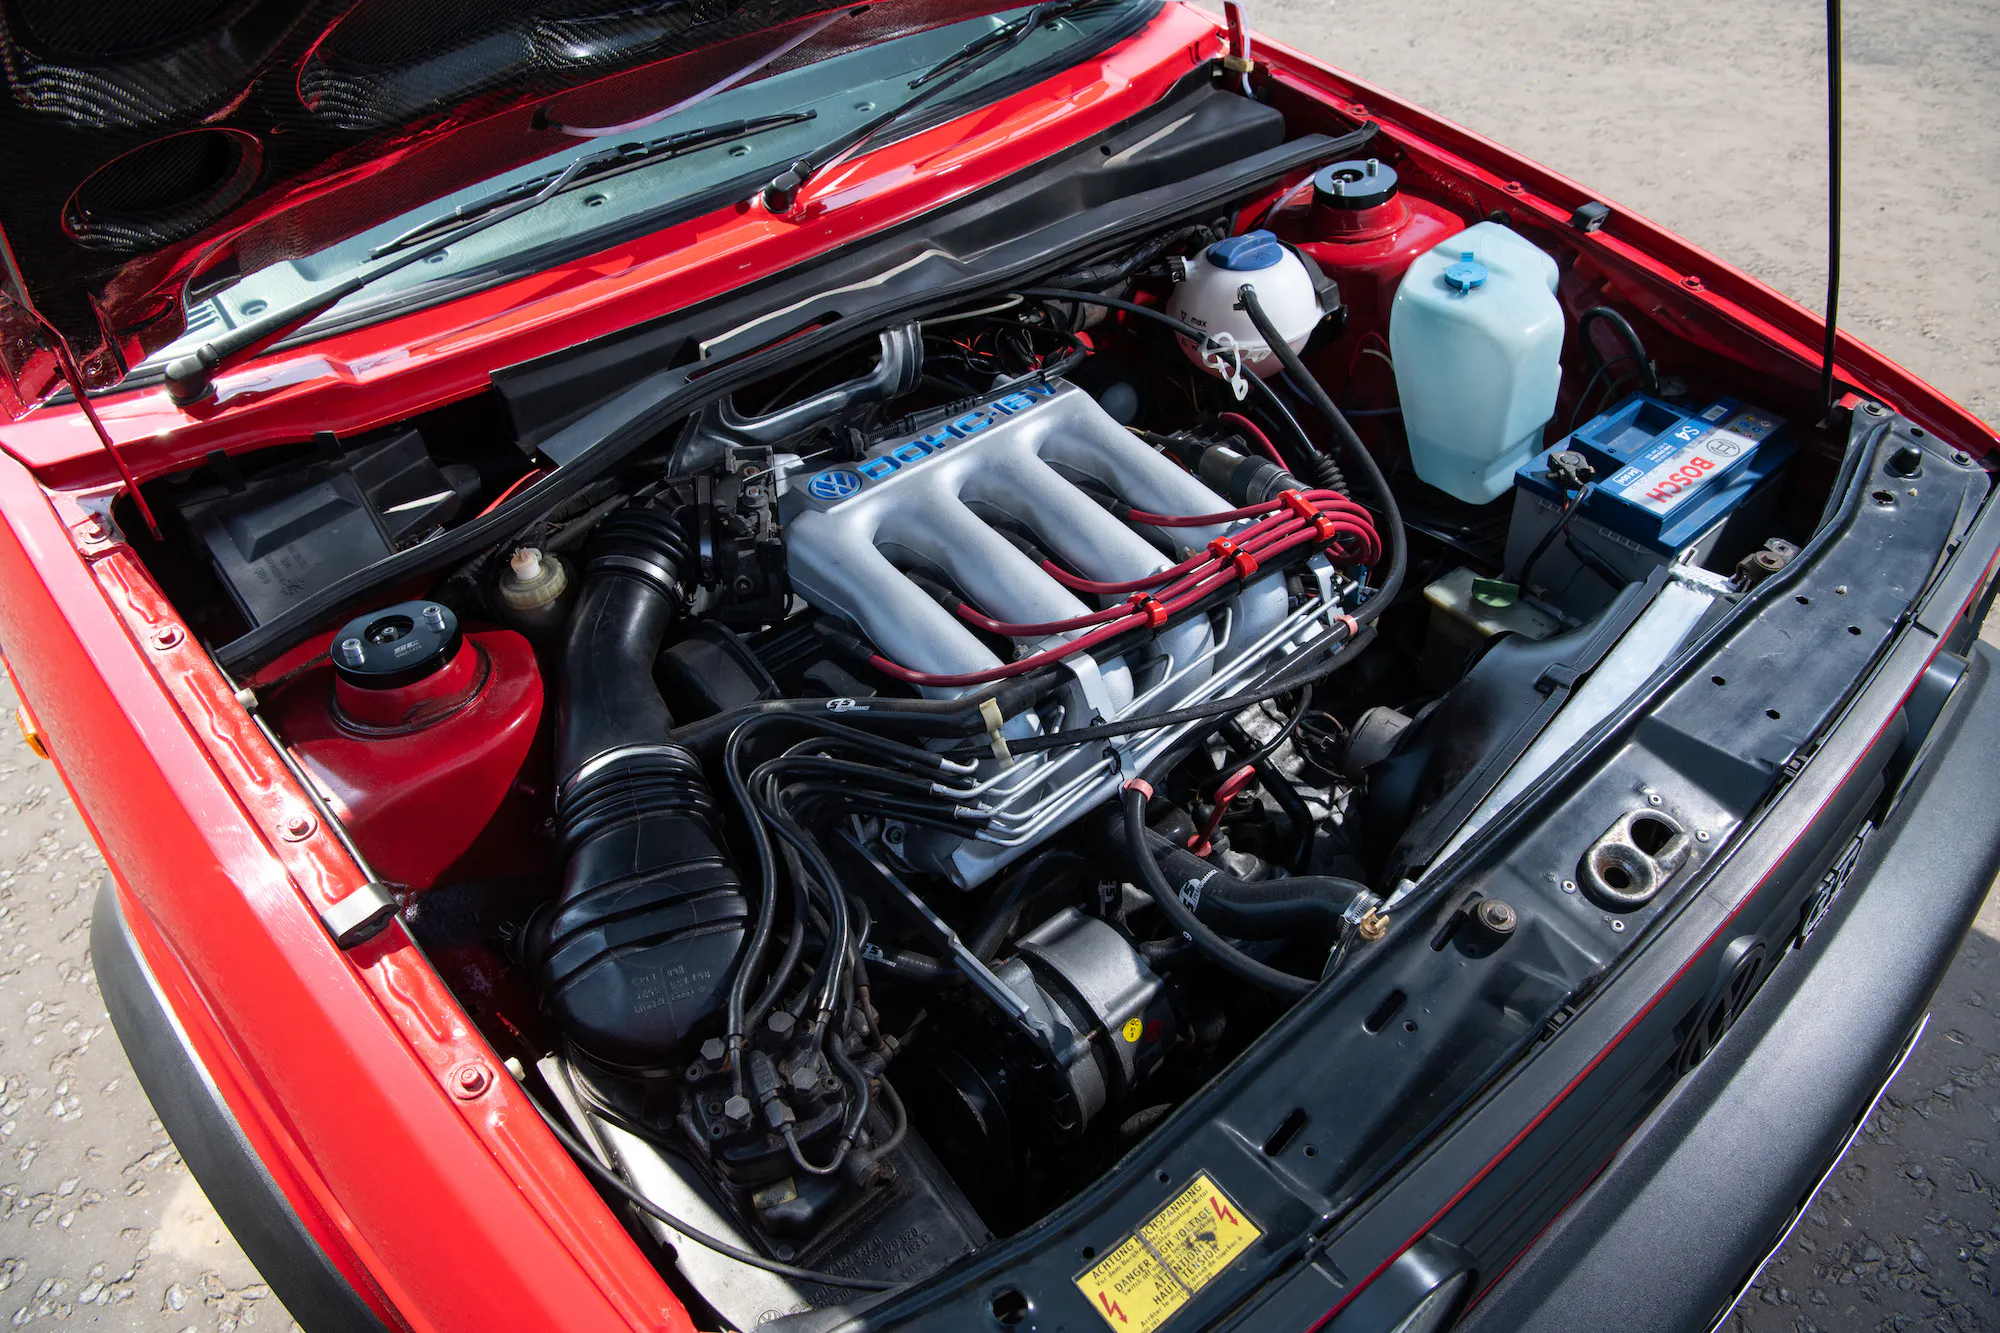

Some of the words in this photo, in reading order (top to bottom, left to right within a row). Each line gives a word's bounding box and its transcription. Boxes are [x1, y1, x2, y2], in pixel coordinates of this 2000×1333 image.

[1191, 317, 1207, 327] max
[1674, 425, 1701, 441] S4
[1645, 456, 1716, 504] BOSCH
[1095, 1277, 1107, 1287] Vor
[1108, 1265, 1122, 1277] dem
[1121, 1243, 1148, 1266] Berühre
[1191, 1189, 1209, 1206] Motor
[1092, 1242, 1134, 1280] ACHTUNG
[1114, 1259, 1152, 1293] DANGER
[1152, 1277, 1180, 1305] HAUT
[1182, 1243, 1220, 1279] TENSION
[1154, 1242, 1205, 1291] ATTNTION!
[1191, 1265, 1208, 1282] avant
[1208, 1259, 1217, 1268] de
[1215, 1241, 1238, 1260] toucher
[1122, 1279, 1142, 1296] Switch
[1143, 1269, 1152, 1280] off
